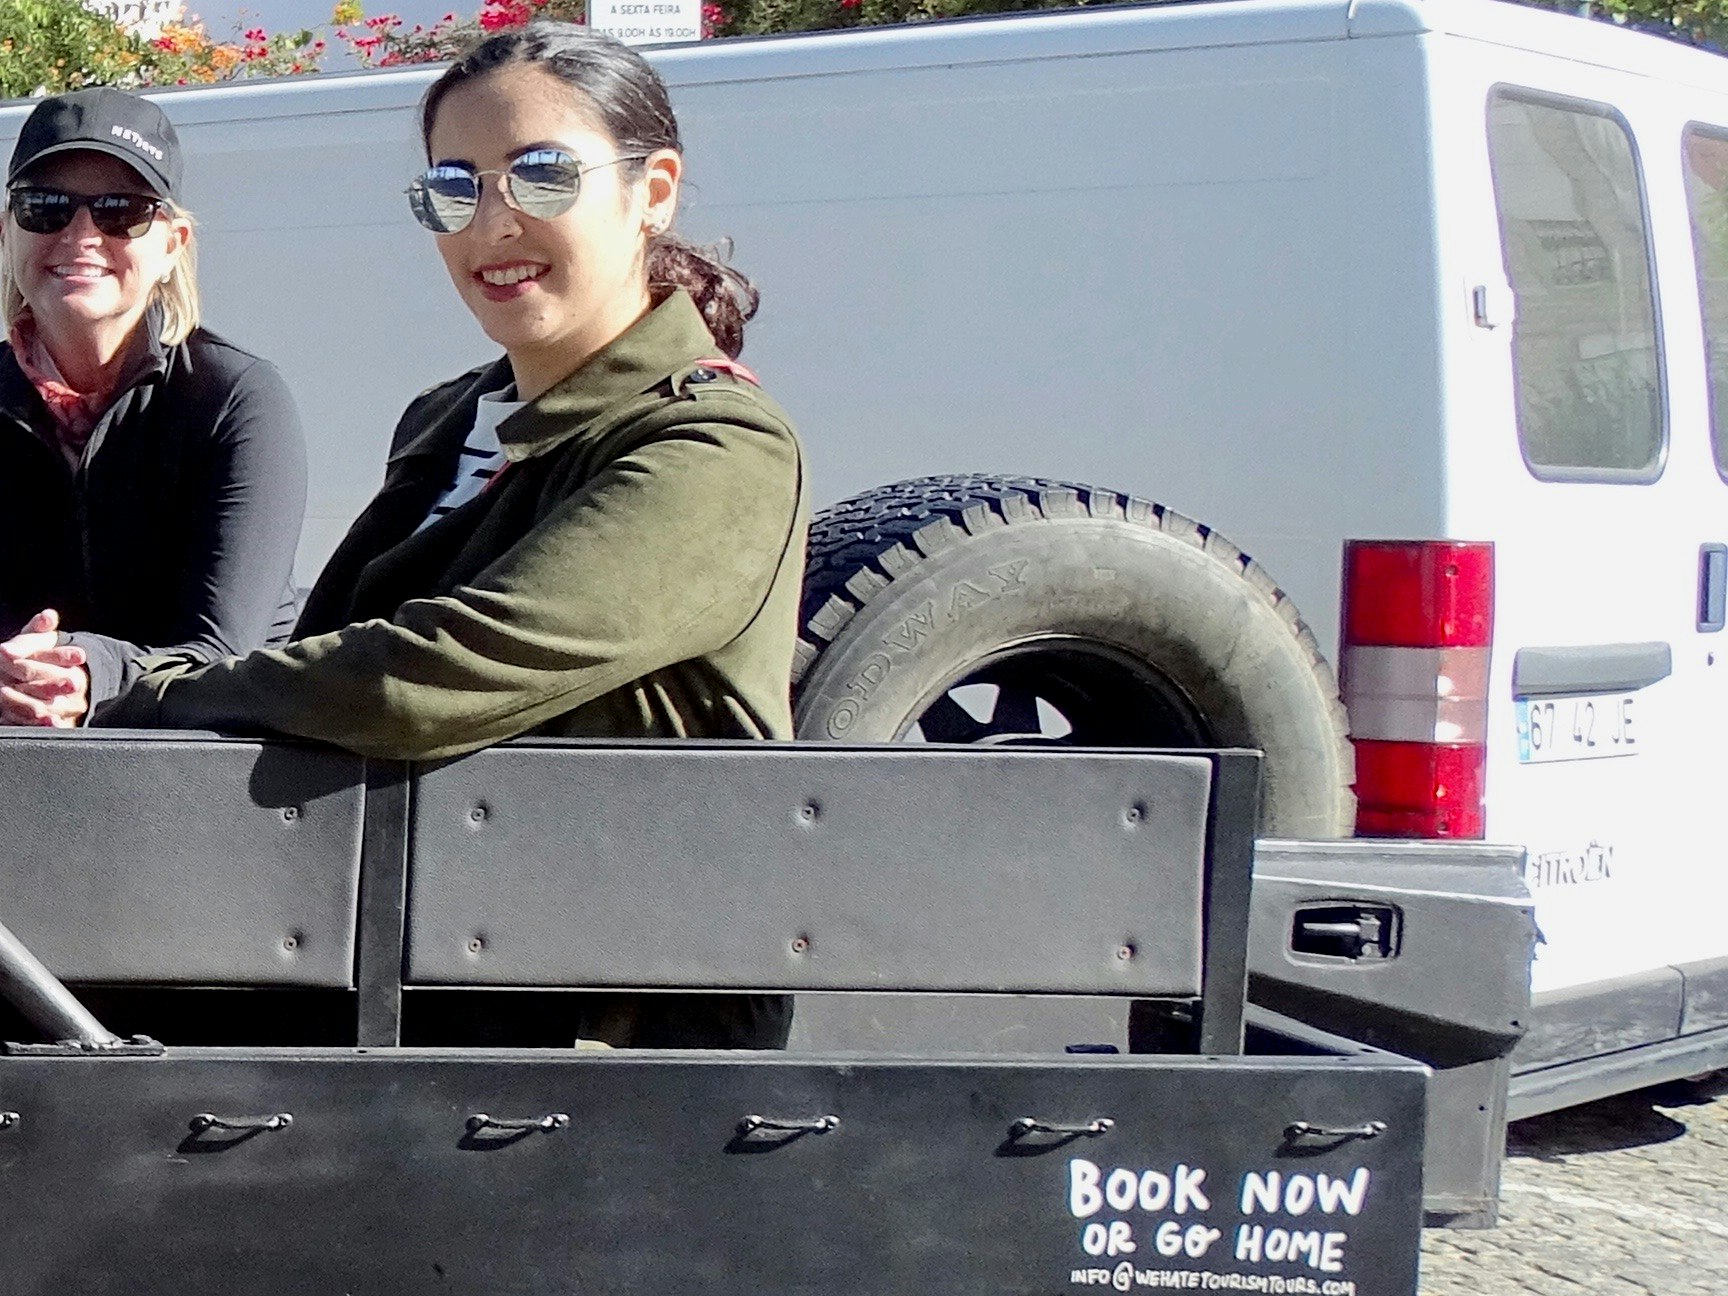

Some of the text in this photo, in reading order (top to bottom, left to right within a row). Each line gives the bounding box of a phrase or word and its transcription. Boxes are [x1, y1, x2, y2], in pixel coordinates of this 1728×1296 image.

[620, 5, 650, 15] SEXTA
[653, 5, 681, 15] FEIRA
[1068, 1157, 1371, 1219] BOOK NOW
[1082, 1220, 1137, 1257] OR
[1234, 1223, 1347, 1273] HOME
